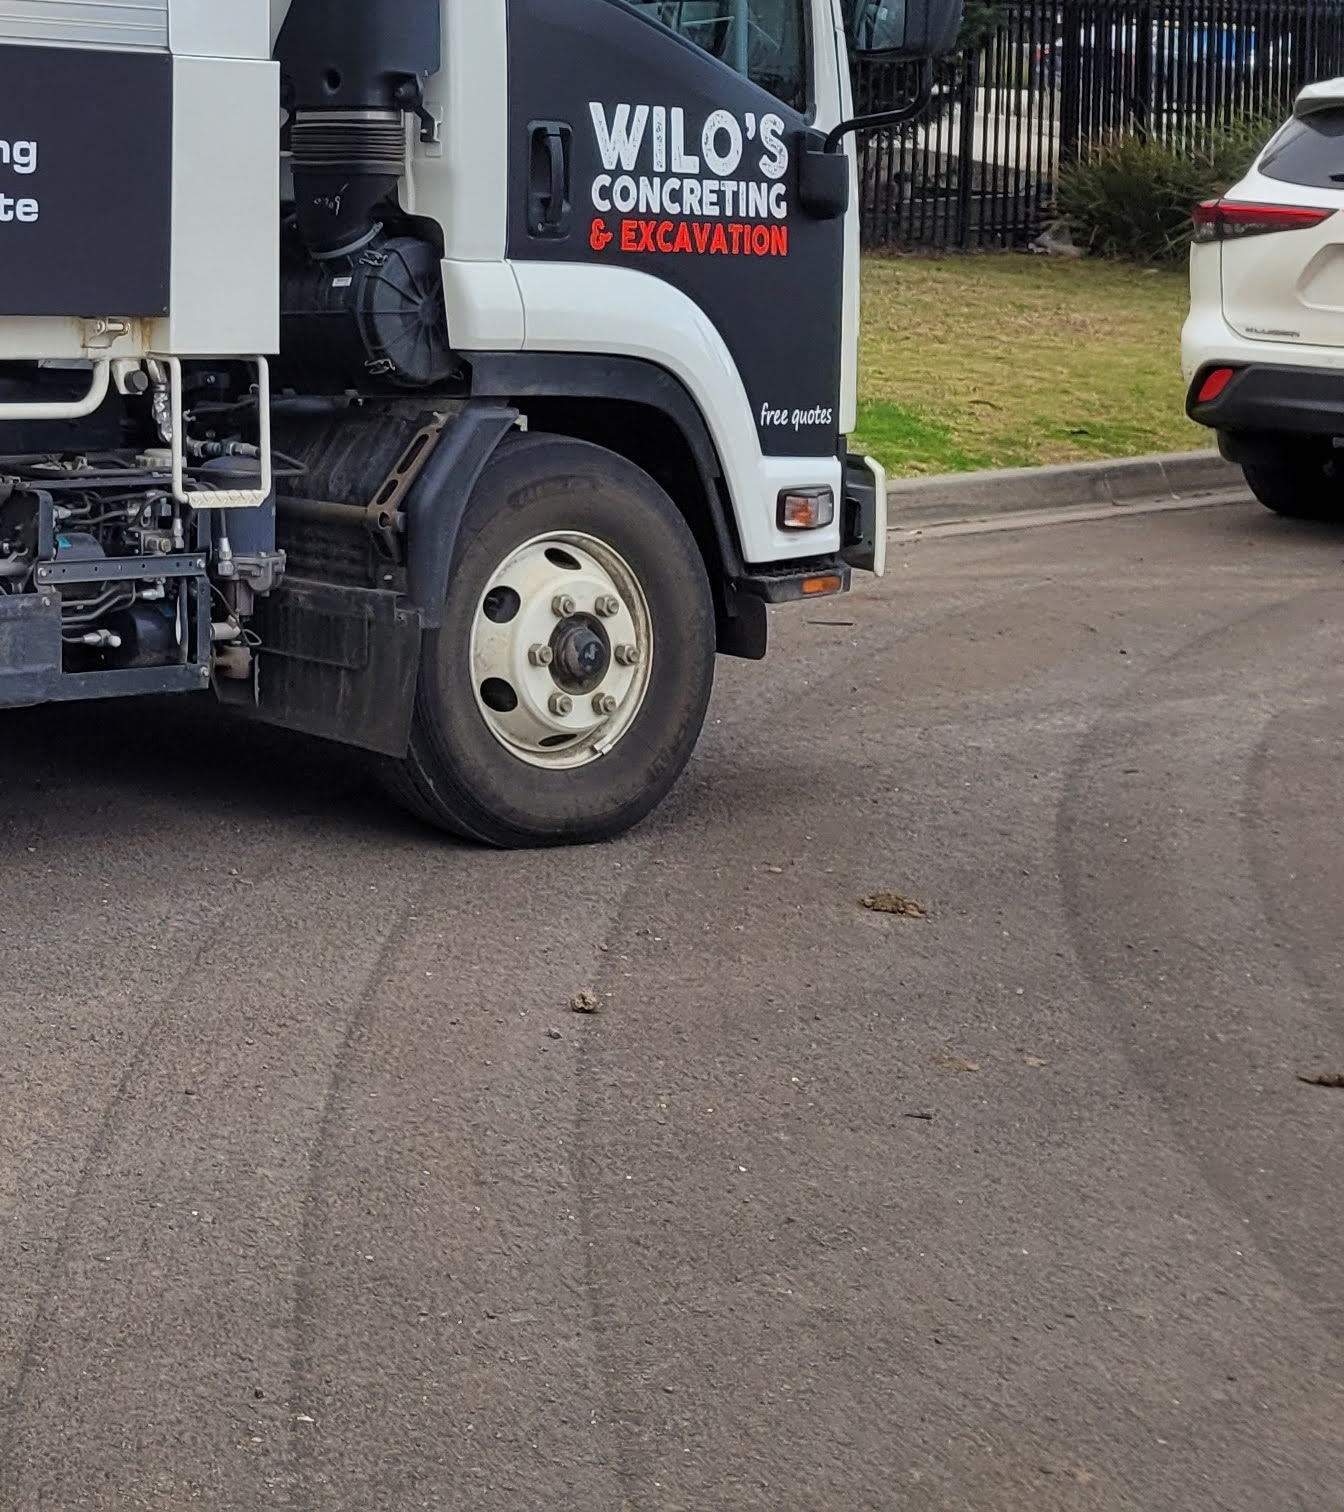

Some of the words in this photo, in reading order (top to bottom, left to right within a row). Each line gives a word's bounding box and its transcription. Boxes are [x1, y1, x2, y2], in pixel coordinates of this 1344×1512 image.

[588, 101, 790, 179] WILO'S
[591, 174, 787, 219] CONCRETING
[590, 218, 613, 251] &
[621, 220, 789, 256] EXCAVATION
[760, 402, 789, 426] free
[791, 404, 833, 432] quotes
